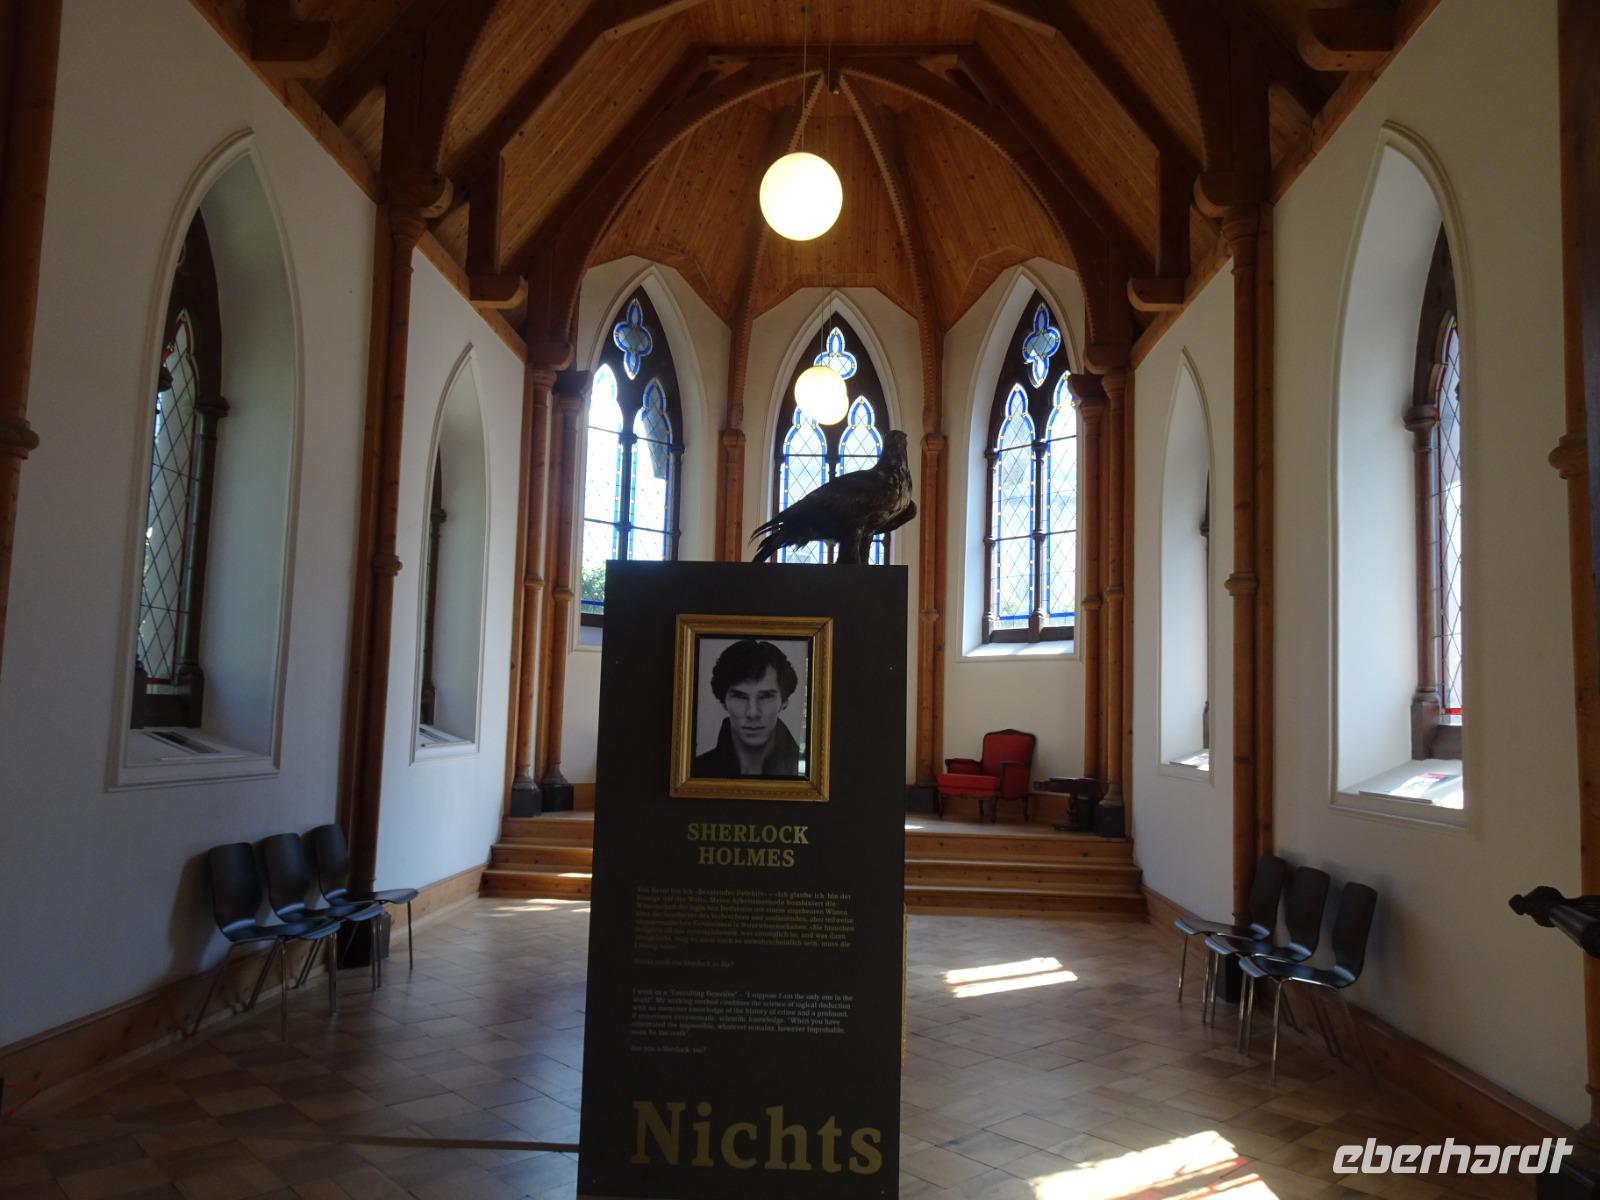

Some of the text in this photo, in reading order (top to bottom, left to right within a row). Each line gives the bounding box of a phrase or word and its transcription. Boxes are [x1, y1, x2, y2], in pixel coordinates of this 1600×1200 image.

[687, 823, 809, 844] SHERLOCK
[698, 846, 795, 867] HOLMES
[631, 1101, 883, 1175] Nichts
